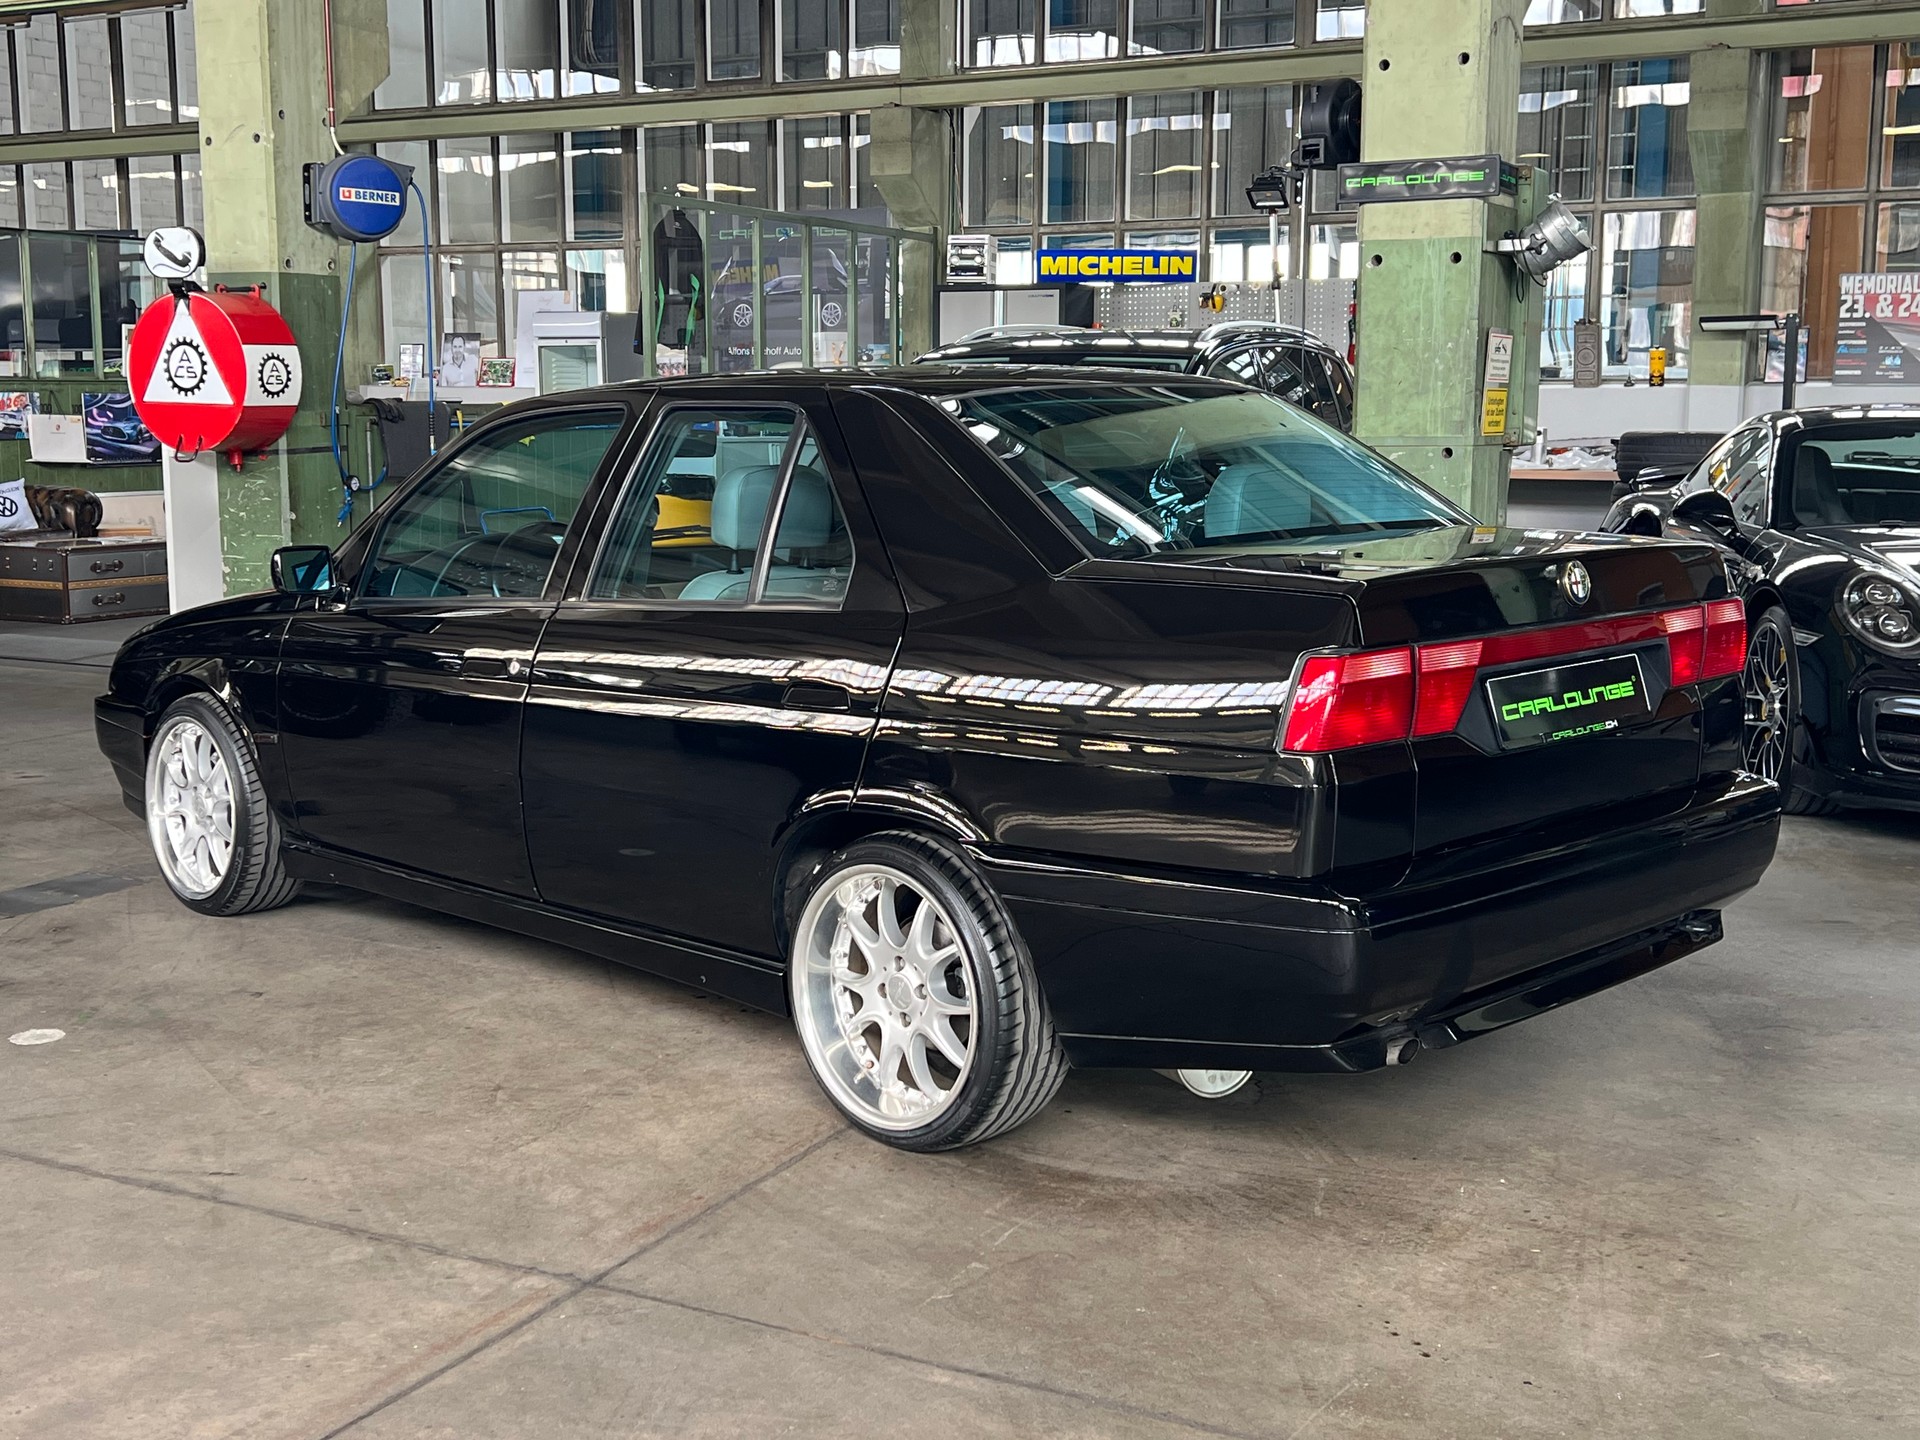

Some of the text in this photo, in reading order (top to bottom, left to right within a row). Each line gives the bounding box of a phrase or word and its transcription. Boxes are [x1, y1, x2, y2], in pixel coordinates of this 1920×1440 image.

[1345, 170, 1485, 188] CARLOUNGE
[354, 190, 397, 203] BERNER
[1040, 256, 1193, 275] MICHELIN
[1841, 275, 1920, 294] MEMORIAL
[1839, 294, 1871, 318] 23.
[1876, 294, 1894, 317] &
[179, 349, 192, 363] A
[752, 346, 782, 356] hoff
[270, 362, 280, 373] A
[1502, 681, 1635, 721] CARLOUNGE
[1552, 719, 1618, 740] CARLOUNGE.CH
